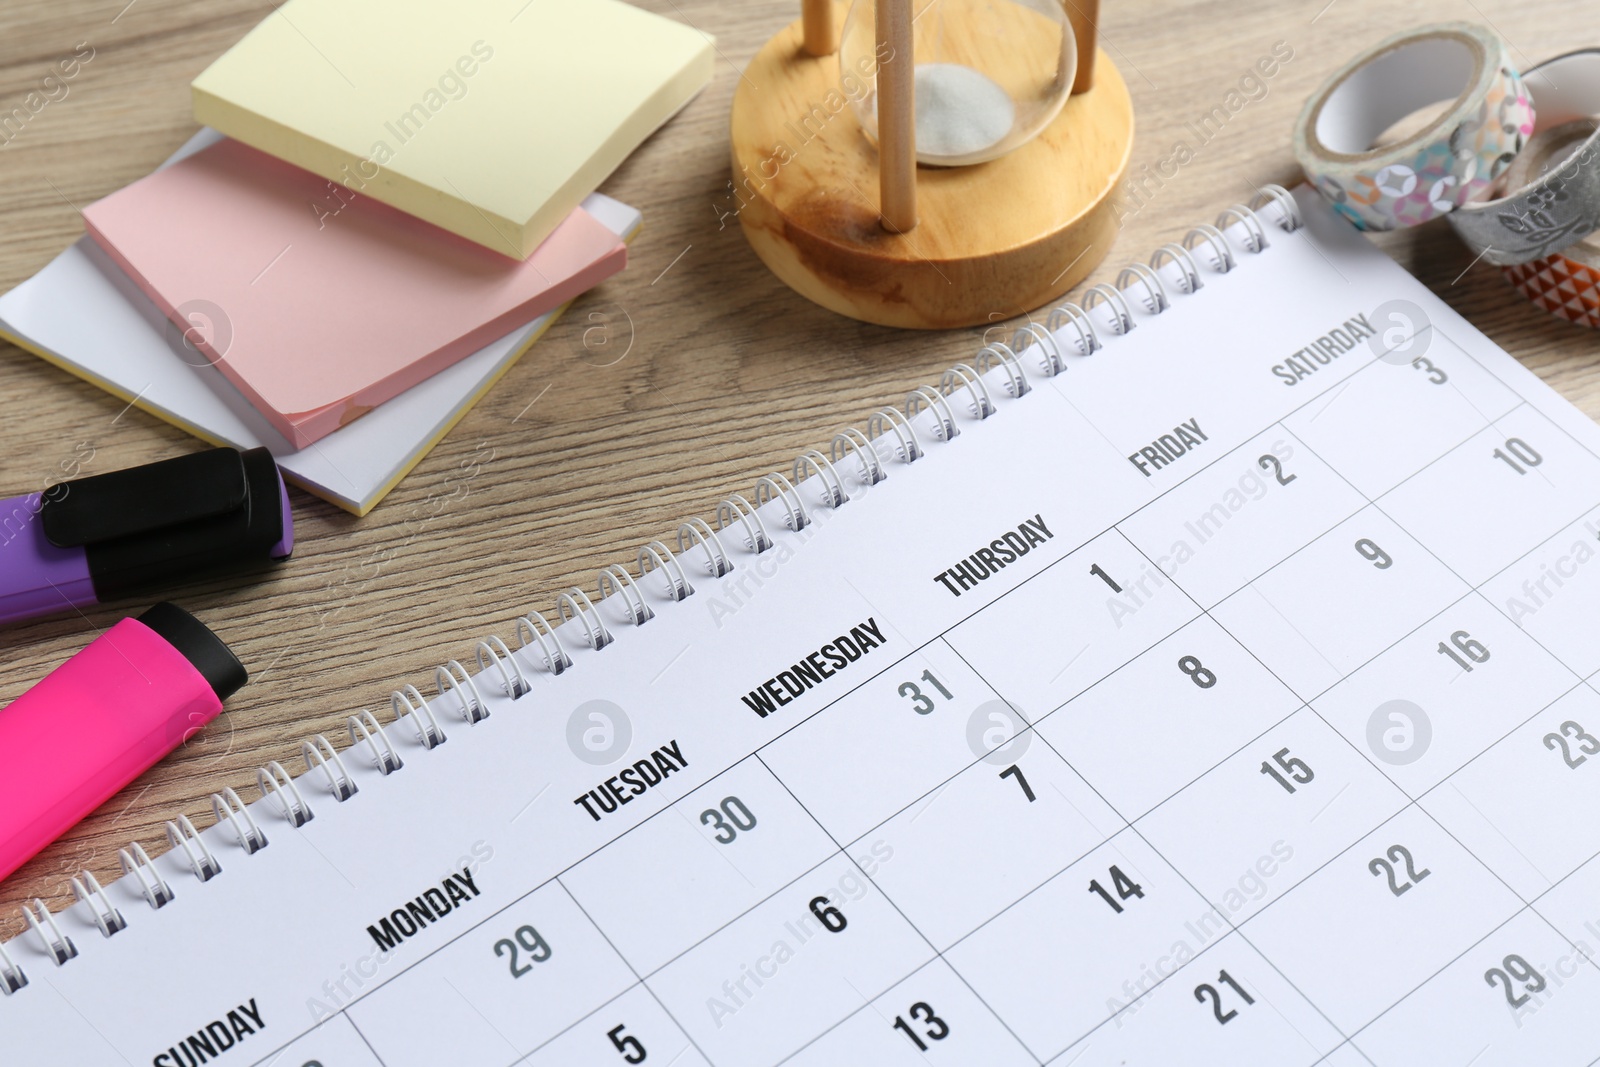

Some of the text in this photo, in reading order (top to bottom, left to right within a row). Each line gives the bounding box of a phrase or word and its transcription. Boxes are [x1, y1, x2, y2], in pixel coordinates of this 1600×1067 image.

[1272, 313, 1377, 386] SATURDAY
[1411, 356, 1448, 385] 3
[1127, 417, 1209, 479] FRIDAY
[1258, 455, 1297, 486] 2
[1493, 438, 1542, 475] 10
[934, 513, 1054, 598] THURSDAY
[1355, 539, 1392, 569] 9
[1090, 564, 1122, 593] 1
[740, 617, 888, 719] WEDNESDAY
[1178, 656, 1216, 688] 8
[1437, 631, 1490, 672] 16
[898, 669, 953, 715] 31
[1543, 721, 1600, 770] 23
[574, 740, 690, 822] TUESDAY
[999, 764, 1036, 802] 7
[1260, 747, 1314, 794] 15
[700, 796, 757, 844] 30
[1088, 865, 1145, 913] 14
[1369, 845, 1431, 897] 22
[367, 867, 480, 952] MONDAY
[809, 896, 847, 933] 6
[494, 925, 551, 979] 29
[1194, 970, 1255, 1025] 21
[1484, 954, 1546, 1009] 29
[607, 1024, 646, 1064] 5
[893, 1002, 949, 1051] 13
